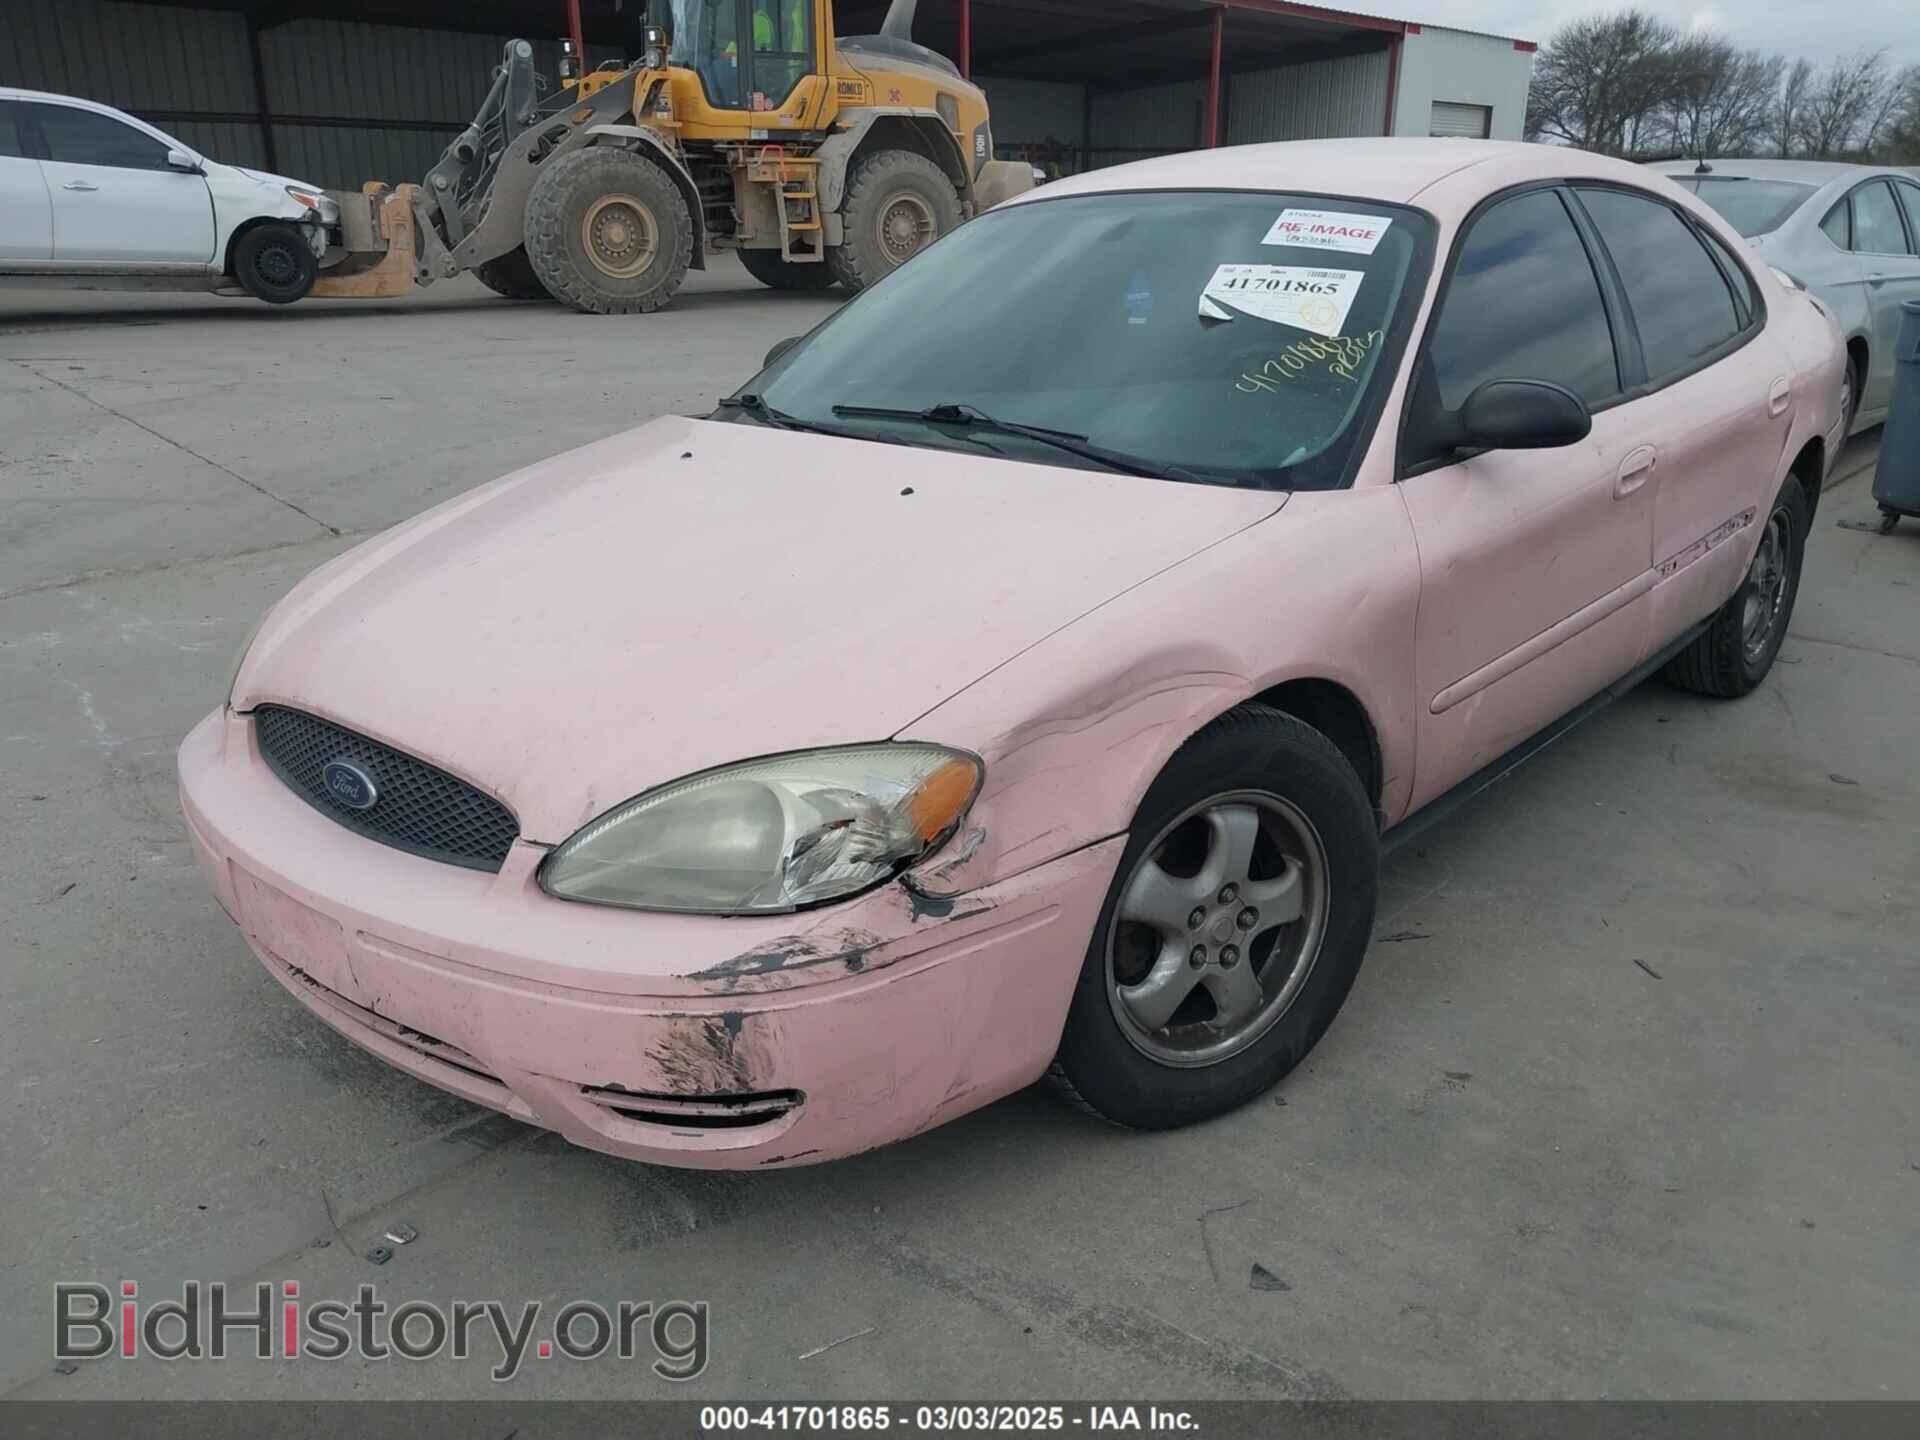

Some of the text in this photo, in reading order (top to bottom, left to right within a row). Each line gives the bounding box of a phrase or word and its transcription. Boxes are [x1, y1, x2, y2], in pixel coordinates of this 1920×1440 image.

[1278, 221, 1377, 240] RE-IMAGE
[1223, 277, 1340, 295] 41701865
[332, 770, 360, 800] Ford
